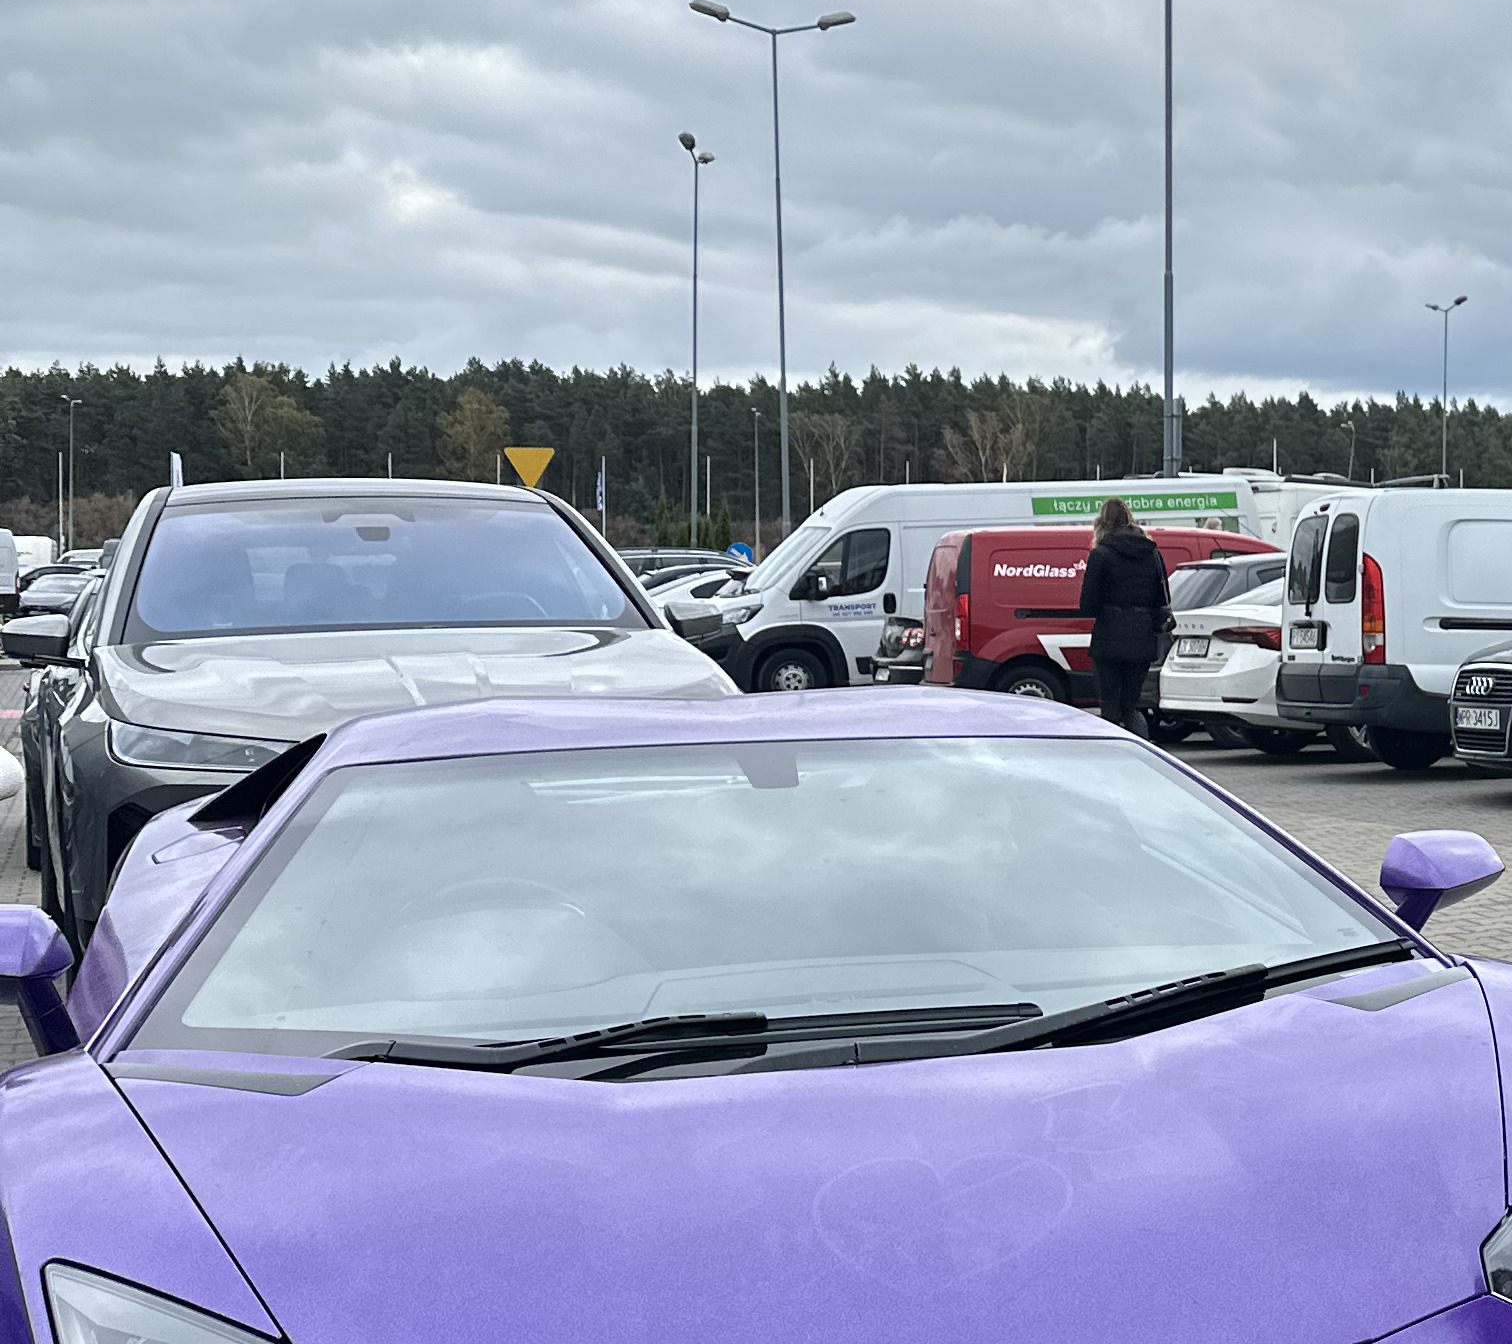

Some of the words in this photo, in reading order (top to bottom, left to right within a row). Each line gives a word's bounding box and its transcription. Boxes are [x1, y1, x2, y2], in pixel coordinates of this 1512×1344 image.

[1053, 498, 1091, 513] łączy
[1167, 494, 1218, 510] energia
[993, 563, 1077, 578] NordGlass
[828, 603, 876, 611] TRANSPORT
